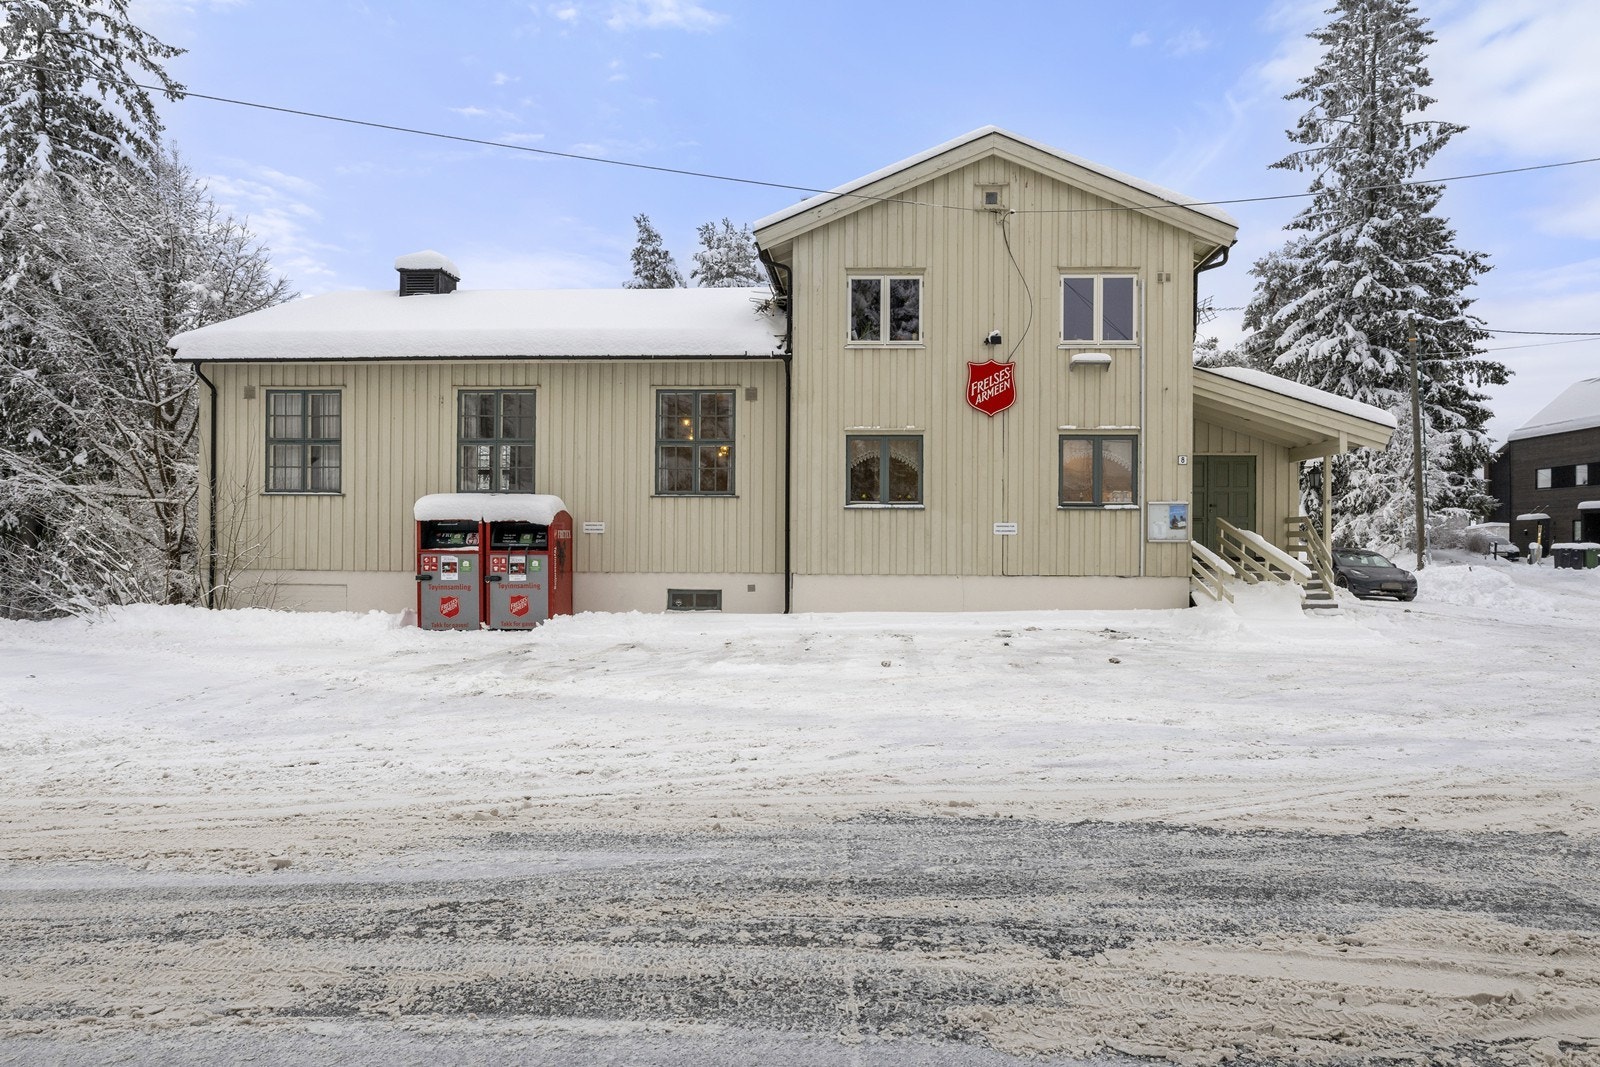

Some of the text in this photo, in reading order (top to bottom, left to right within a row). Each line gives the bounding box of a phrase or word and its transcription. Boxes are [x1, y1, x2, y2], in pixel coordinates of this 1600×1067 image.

[971, 367, 1011, 396] FRELSES-
[975, 379, 1010, 405] ARMEEN
[1180, 456, 1185, 464] 8
[428, 583, 472, 592] Tøyinnsamling
[498, 582, 541, 590] Tøyinnsamling
